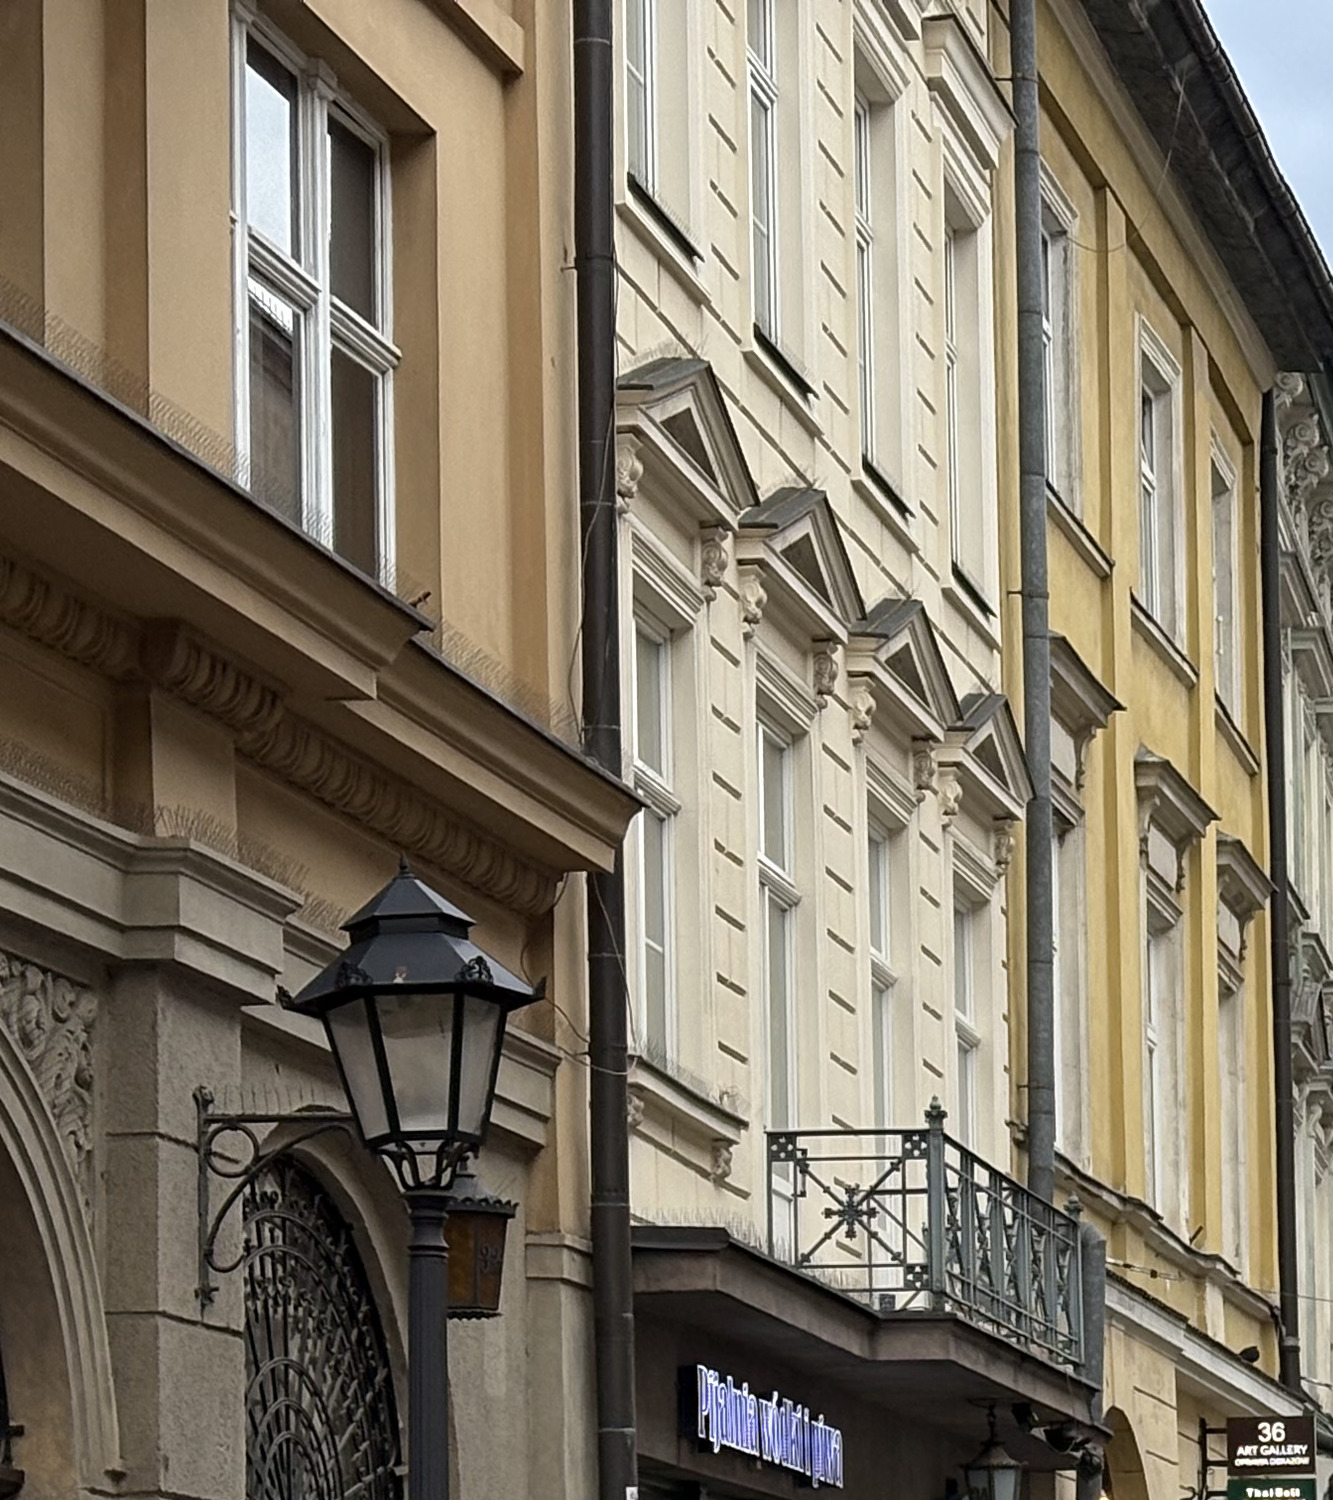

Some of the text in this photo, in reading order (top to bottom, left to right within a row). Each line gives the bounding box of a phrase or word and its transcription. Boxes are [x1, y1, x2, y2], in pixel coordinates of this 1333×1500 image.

[1257, 1422, 1286, 1442] 36
[1236, 1444, 1308, 1456] ART GALLERY
